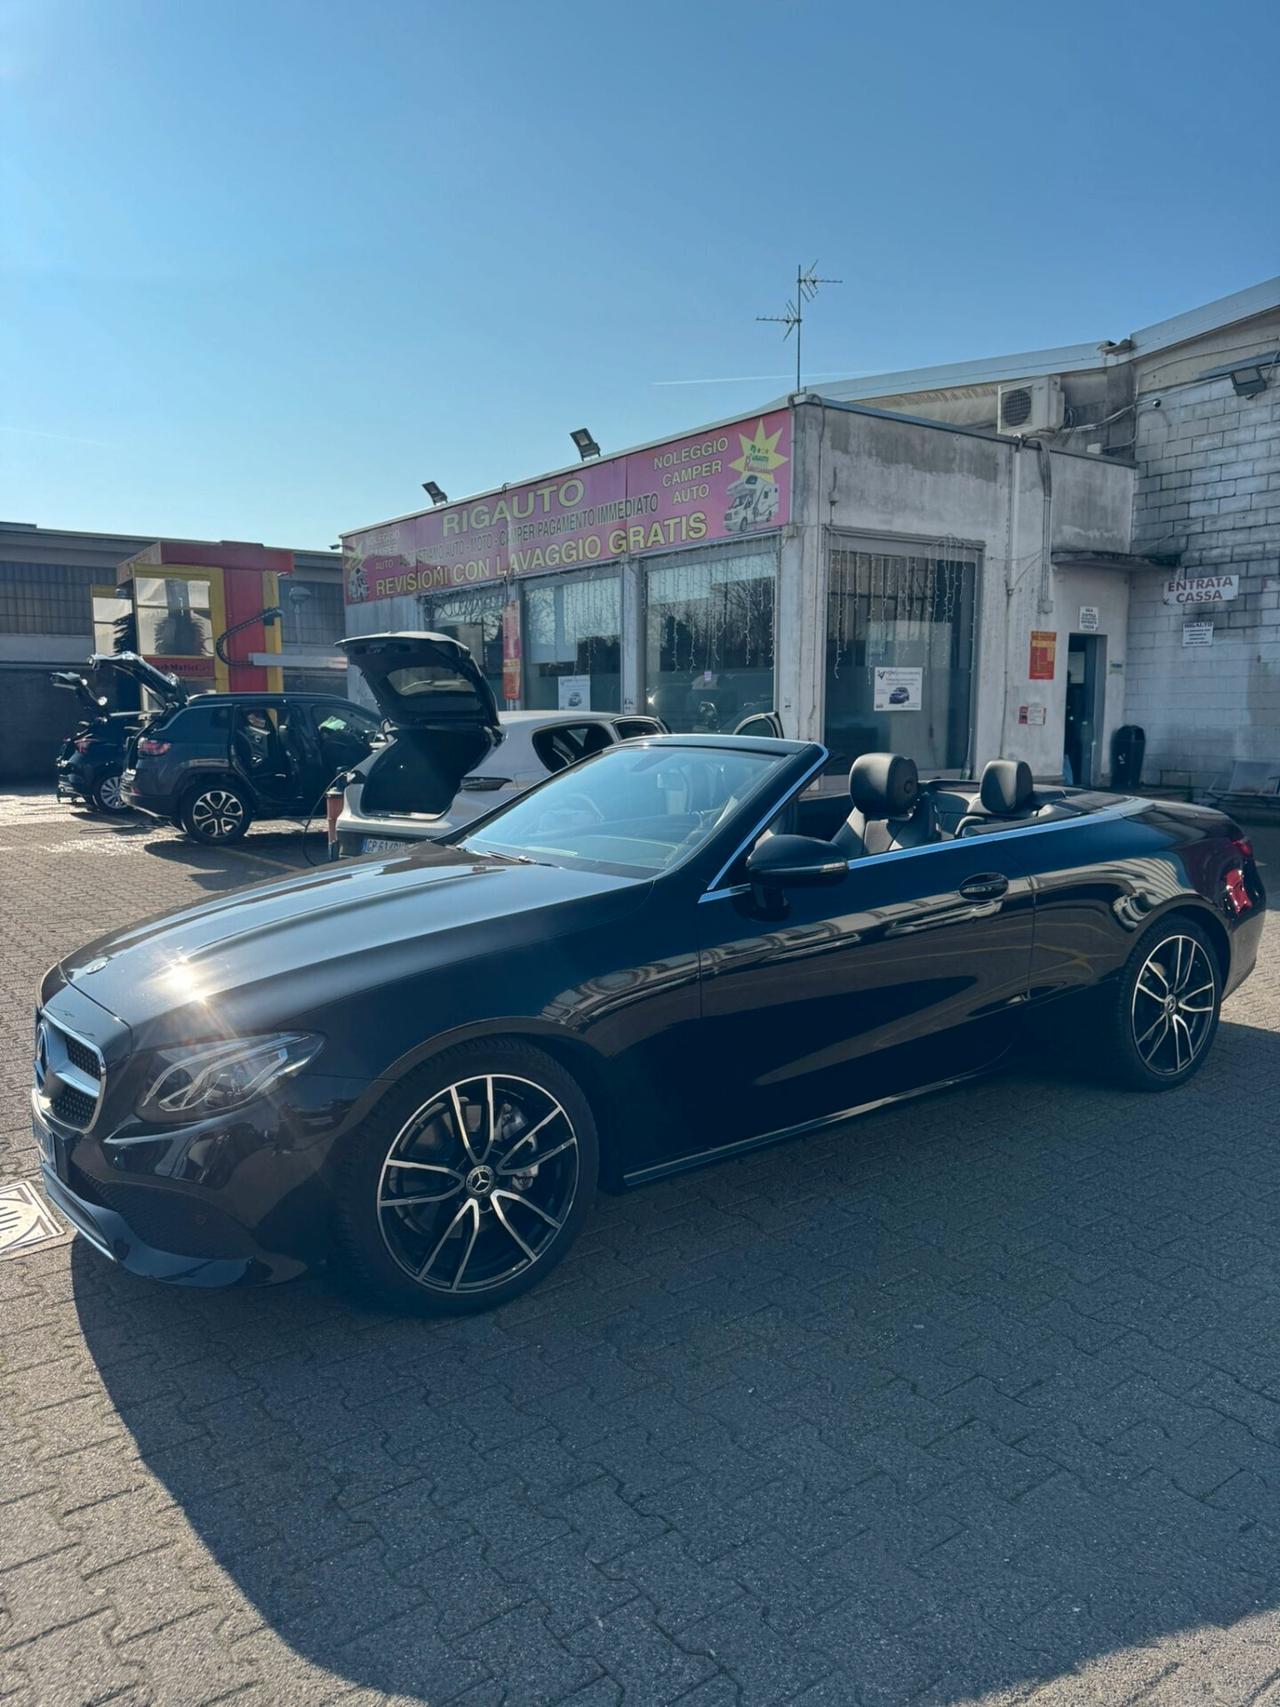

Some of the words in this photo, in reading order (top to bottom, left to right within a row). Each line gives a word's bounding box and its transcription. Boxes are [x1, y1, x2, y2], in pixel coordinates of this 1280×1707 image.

[654, 436, 729, 471] NOLEGGIO
[662, 460, 722, 487] CAMPER
[442, 478, 585, 537] RIGAUTO
[672, 484, 710, 506] AUTO
[471, 534, 493, 553] MOTO
[499, 523, 535, 546] CAMPER
[537, 508, 596, 538] PAGAMENTO
[597, 492, 659, 525] IMMEDIATO
[375, 566, 448, 596] REVISIONI
[452, 558, 490, 583] CON
[496, 535, 601, 576] LAVAGGIO
[608, 512, 708, 555] GRATIS
[1168, 576, 1233, 592] ENTRATA
[1176, 589, 1223, 603] CASSA
